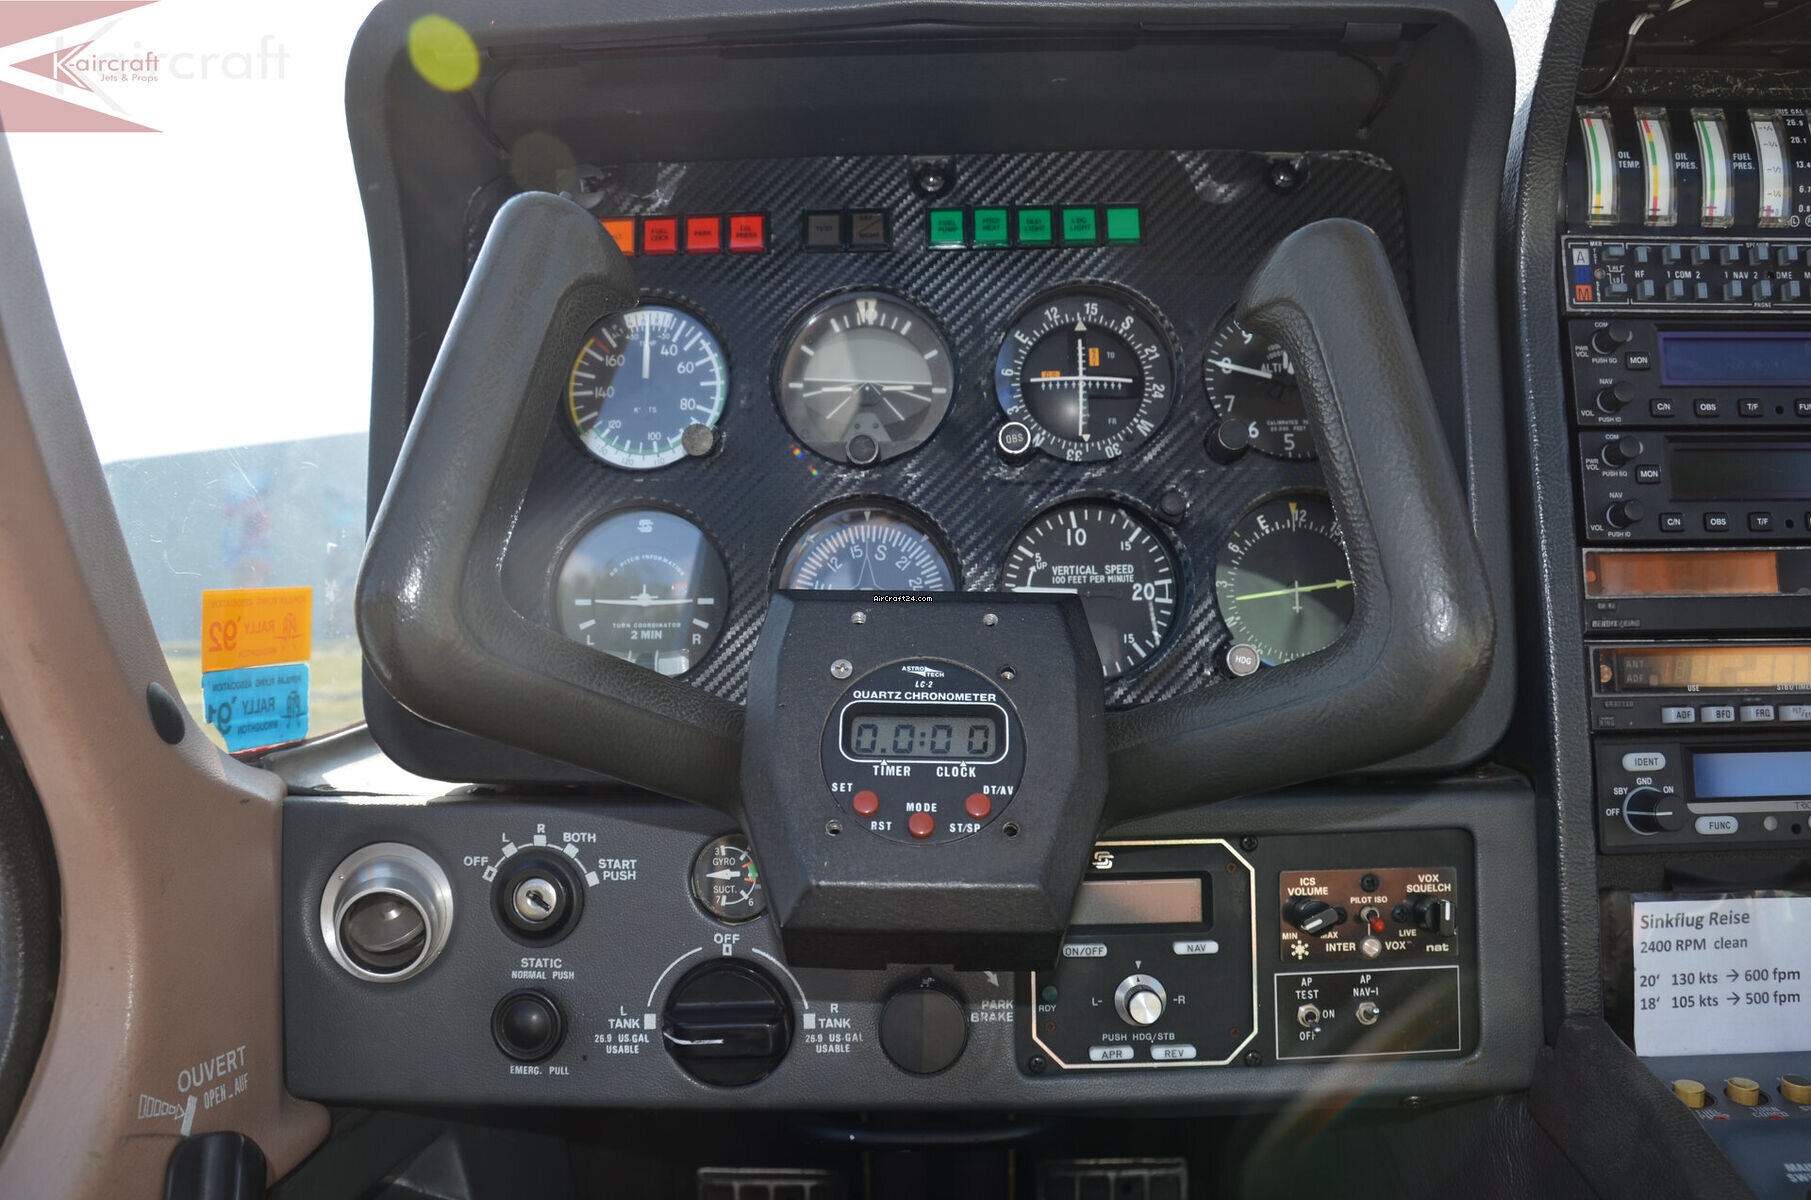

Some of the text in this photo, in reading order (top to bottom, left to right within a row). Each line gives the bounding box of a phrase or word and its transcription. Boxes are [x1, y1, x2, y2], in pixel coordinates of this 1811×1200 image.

[1733, 153, 1752, 161] FUEL
[1618, 161, 1640, 169] TEMP.
[1733, 162, 1756, 170] PRES.
[1084, 303, 1098, 315] 15
[1044, 307, 1060, 321] 12
[660, 344, 678, 356] 40
[1144, 345, 1160, 360] 21
[605, 355, 625, 367] 160
[677, 362, 694, 374] 60
[595, 386, 615, 398] 140
[1152, 384, 1165, 399] 24
[680, 399, 696, 410] 80
[1700, 403, 1717, 411] OBS
[608, 419, 622, 429] 120
[647, 431, 661, 441] 100
[1005, 433, 1024, 444] OBS
[1284, 434, 1295, 450] 5
[1104, 442, 1122, 458] 30
[1066, 450, 1083, 462] 33
[1757, 518, 1768, 526] T/F
[1067, 528, 1087, 546] 10
[1121, 541, 1131, 551] 15
[850, 544, 864, 559] 15
[827, 557, 842, 572] 12
[895, 555, 912, 571] 21
[1036, 562, 1048, 570] UP
[1052, 564, 1134, 575] VERTICAL SPEED
[1052, 574, 1135, 584] 100 FEET PER MINUTE
[1132, 583, 1155, 600] 20
[630, 630, 662, 640] 2 MIN
[1124, 634, 1135, 643] 15
[1235, 655, 1252, 664] HDG
[853, 691, 996, 701] QUARTZ CHRONOMETER
[1677, 711, 1691, 719] ADF
[873, 766, 911, 776] TIMER
[936, 767, 976, 777] CLOCK
[1637, 777, 1652, 785] GND
[832, 783, 853, 792] SET
[983, 786, 1013, 795] DT/AV
[906, 803, 937, 812] MODE
[1606, 808, 1620, 816] OFF
[537, 824, 545, 833] R
[871, 821, 892, 831] RST
[950, 823, 981, 833] ST/SP
[1709, 821, 1731, 829] FUNC
[502, 833, 509, 842] L
[563, 832, 596, 843] BOTH
[464, 857, 488, 866] OFF
[599, 859, 637, 869] START
[712, 858, 735, 866] GYRO
[603, 871, 636, 880] PUSH
[1418, 874, 1440, 883] VOX
[1300, 877, 1316, 886] ICS
[713, 885, 737, 894] SUCT.
[1288, 887, 1329, 896] VOLUME
[1407, 884, 1451, 893] SQUELCH
[1350, 896, 1372, 904] PILOT
[1641, 910, 1750, 929] Sinkflug Reise
[1282, 932, 1298, 940] MIN
[1399, 929, 1417, 937] LIVE
[714, 933, 740, 944] OFF
[1187, 945, 1207, 953] NAV
[1326, 943, 1356, 952] INTER
[1385, 941, 1406, 950] VOX
[1426, 943, 1449, 952] nat
[1641, 937, 1748, 953] 2400 RPM clean
[1065, 946, 1104, 956] ON/OFF
[521, 958, 562, 969] STATIC
[512, 971, 574, 979] NORMAL PUSH
[1360, 975, 1371, 984] AP
[1672, 973, 1695, 986] 130
[1699, 972, 1718, 985] kts
[1745, 969, 1769, 982] 600
[1772, 968, 1800, 983] fpm
[1301, 977, 1312, 986] AP
[1296, 990, 1319, 999] TEST
[1672, 991, 1800, 1008] 105 kts 500 fpm
[830, 1003, 838, 1013] R
[981, 1000, 1013, 1009] PARK
[620, 1006, 627, 1016] L
[1322, 1010, 1335, 1018] ON
[970, 1012, 1013, 1022] BRAKE
[608, 1019, 640, 1029] TANK
[818, 1018, 851, 1028] TANK
[595, 1034, 612, 1043] 26.9
[805, 1034, 823, 1042] 26.9
[1102, 1033, 1175, 1042] PUSH HDG/STB
[606, 1045, 639, 1054] USABLE
[816, 1044, 850, 1053] USABLE
[1164, 1049, 1184, 1057] REV
[1101, 1050, 1122, 1059] APR
[178, 1045, 246, 1093] OUVERT
[510, 1066, 569, 1075] EMERG. PULL
[204, 1073, 248, 1109] OPEN AUF
